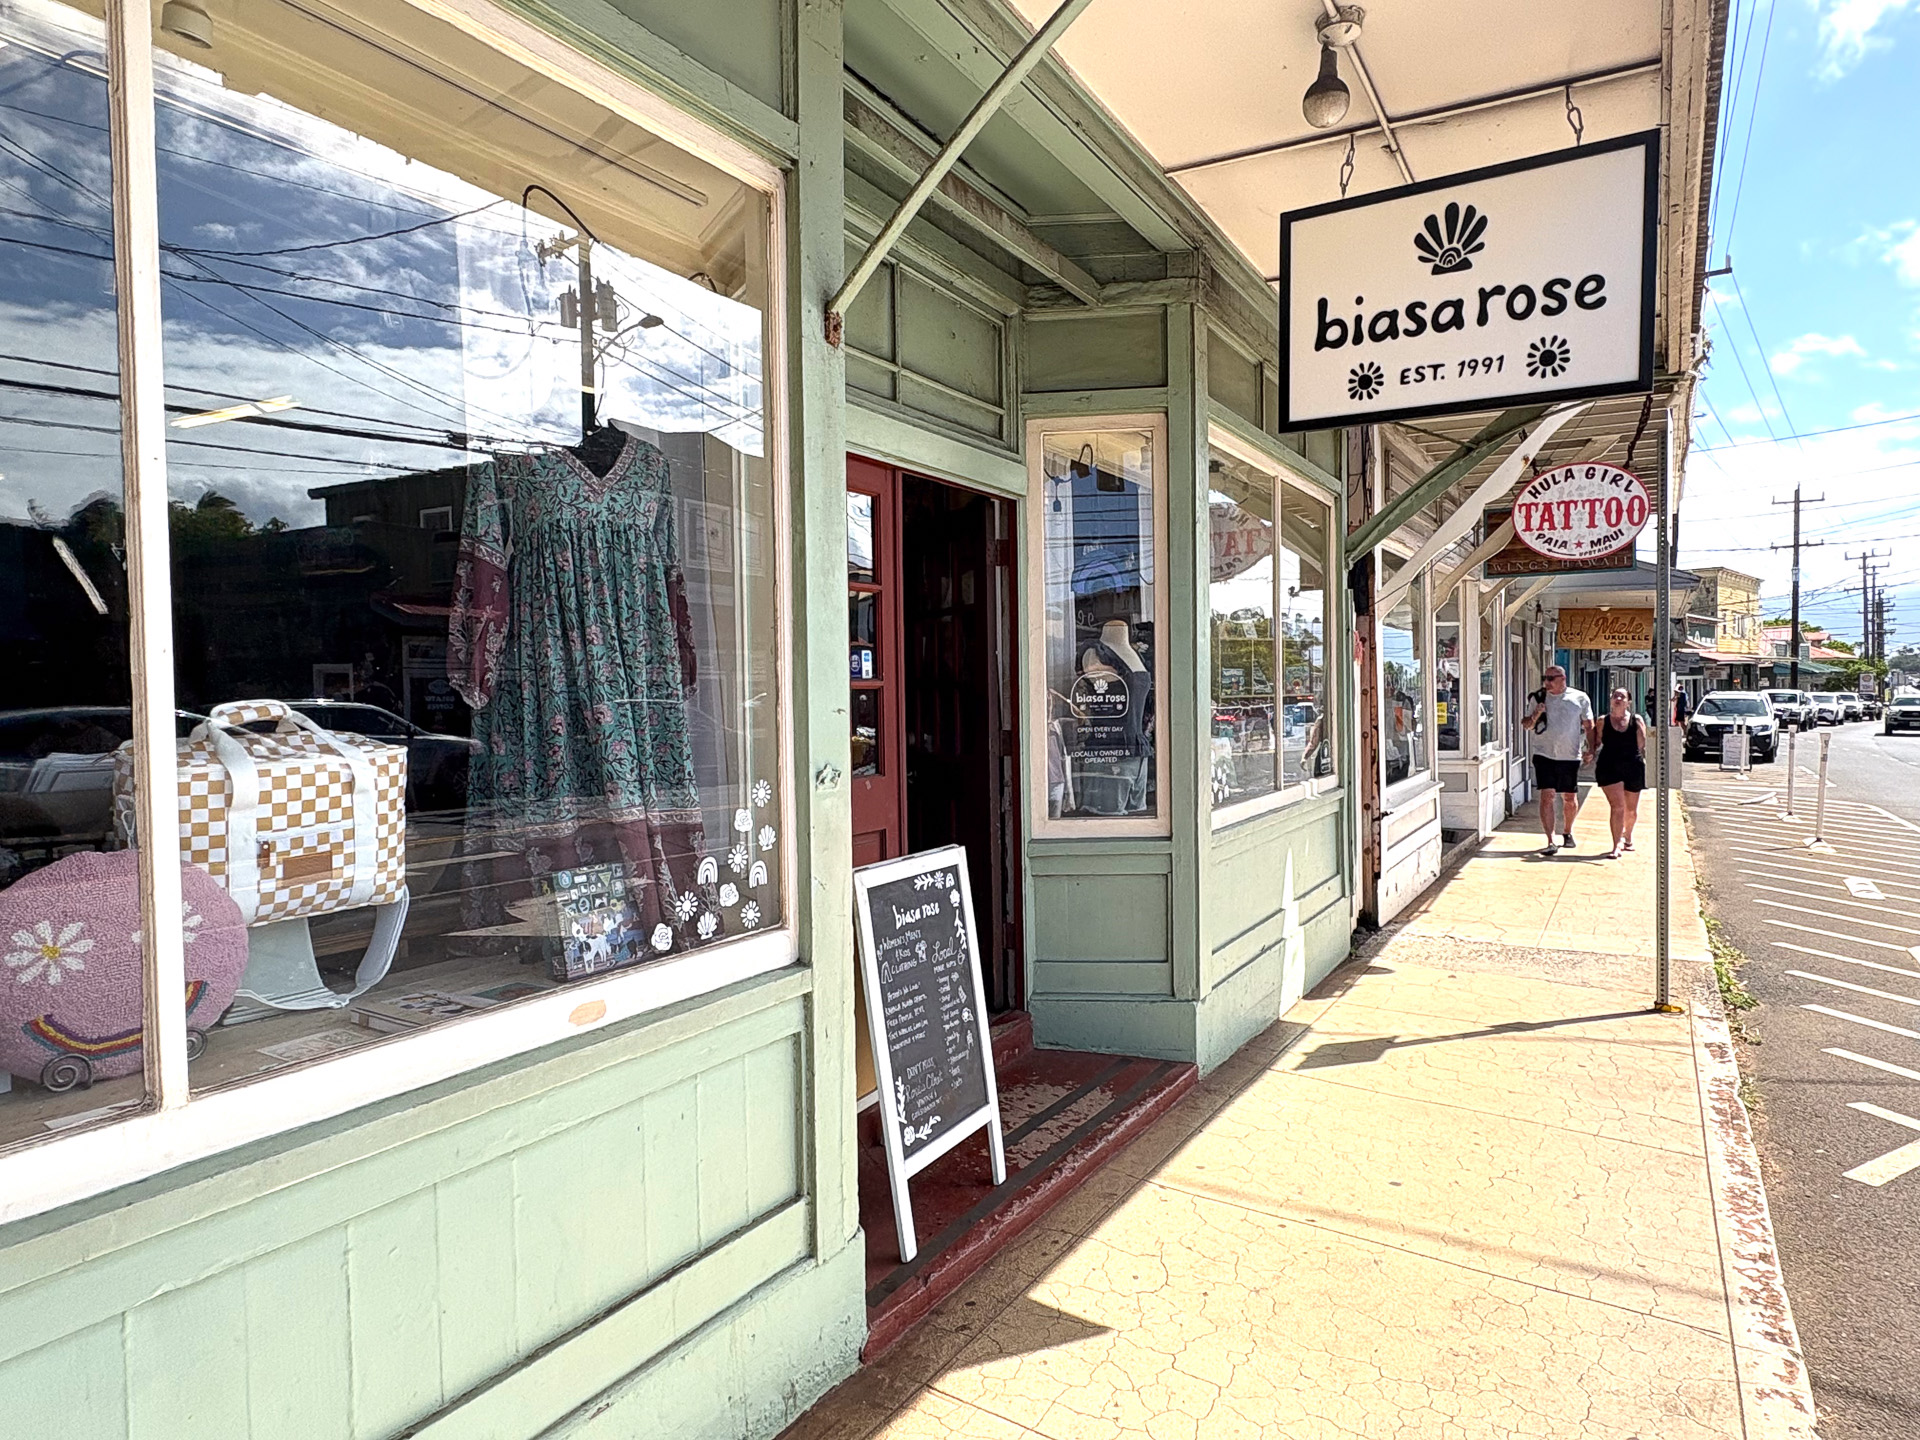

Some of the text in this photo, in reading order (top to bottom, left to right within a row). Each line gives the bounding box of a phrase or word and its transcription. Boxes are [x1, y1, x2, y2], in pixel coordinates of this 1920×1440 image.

[1314, 273, 1607, 352] biasa rose
[1399, 354, 1505, 386] EST. 1991
[1527, 466, 1634, 500] HULA GIRL
[1517, 494, 1647, 533] TATTOO
[1535, 528, 1626, 550] PAIA MAUI
[1578, 543, 1613, 557] UPSTAIRS
[1492, 555, 1630, 572] WINGS HAWAII
[1589, 615, 1645, 642] Mele
[1076, 691, 1126, 703] biasa rose
[892, 902, 940, 930] biasa rose
